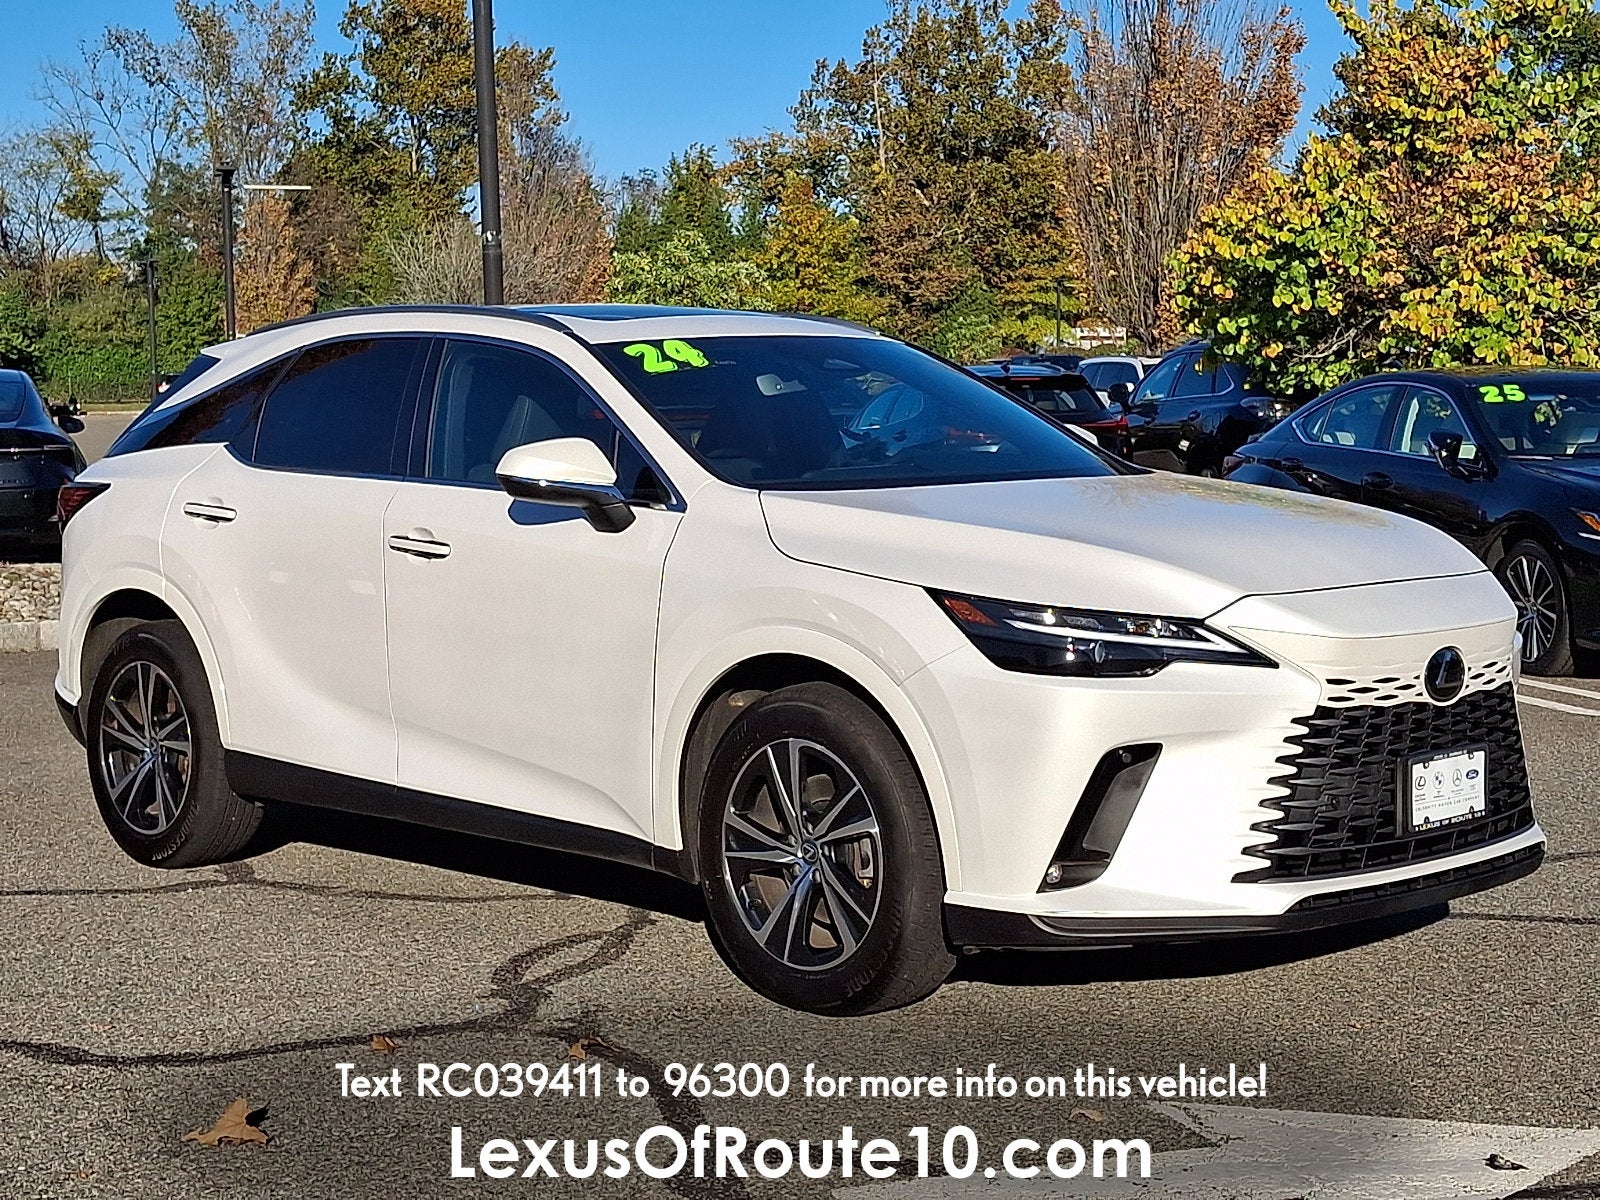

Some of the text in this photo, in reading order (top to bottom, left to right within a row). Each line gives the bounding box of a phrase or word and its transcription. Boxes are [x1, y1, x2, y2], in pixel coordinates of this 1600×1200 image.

[623, 339, 709, 373] 24
[1479, 384, 1525, 403] 25
[1419, 821, 1440, 830] LEXUS
[1451, 814, 1473, 823] ROUTE
